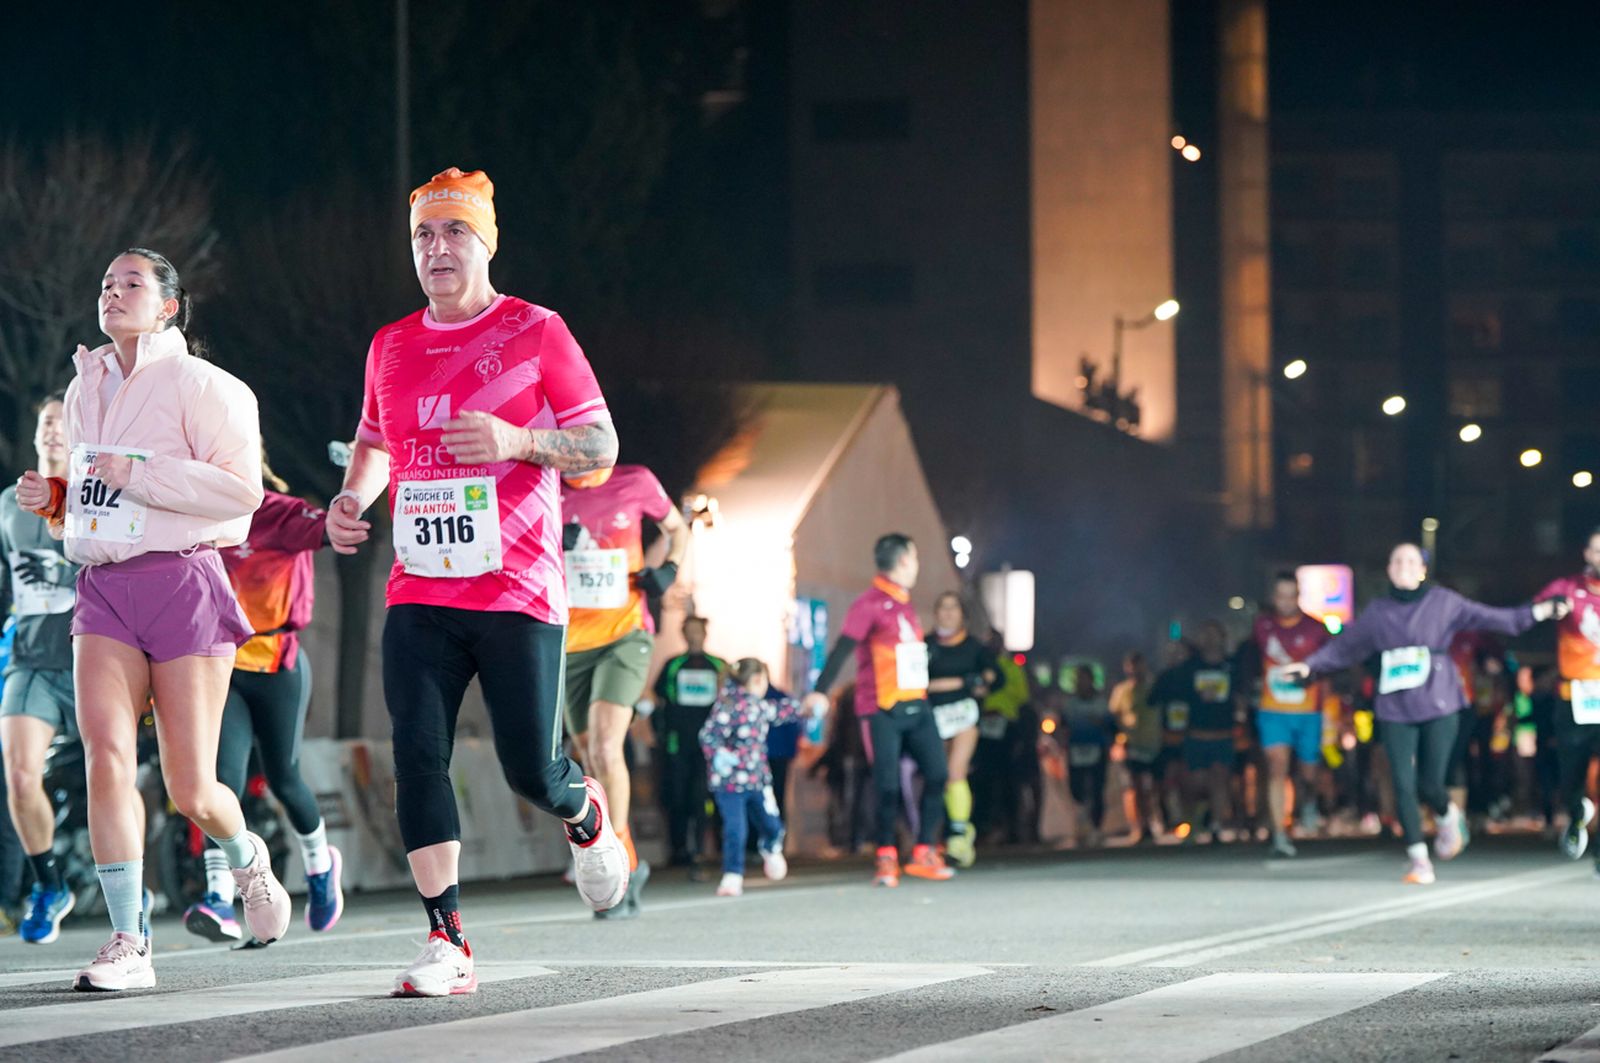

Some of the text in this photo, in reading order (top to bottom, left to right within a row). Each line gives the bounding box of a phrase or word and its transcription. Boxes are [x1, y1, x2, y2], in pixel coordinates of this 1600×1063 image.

[403, 438, 452, 470] Jae
[434, 467, 488, 478] INTERIOR
[81, 478, 122, 508] 502
[413, 491, 454, 501] NOCHE DE
[403, 504, 421, 515] SAN
[423, 501, 456, 513] ANTÓN
[415, 515, 474, 545] 3116
